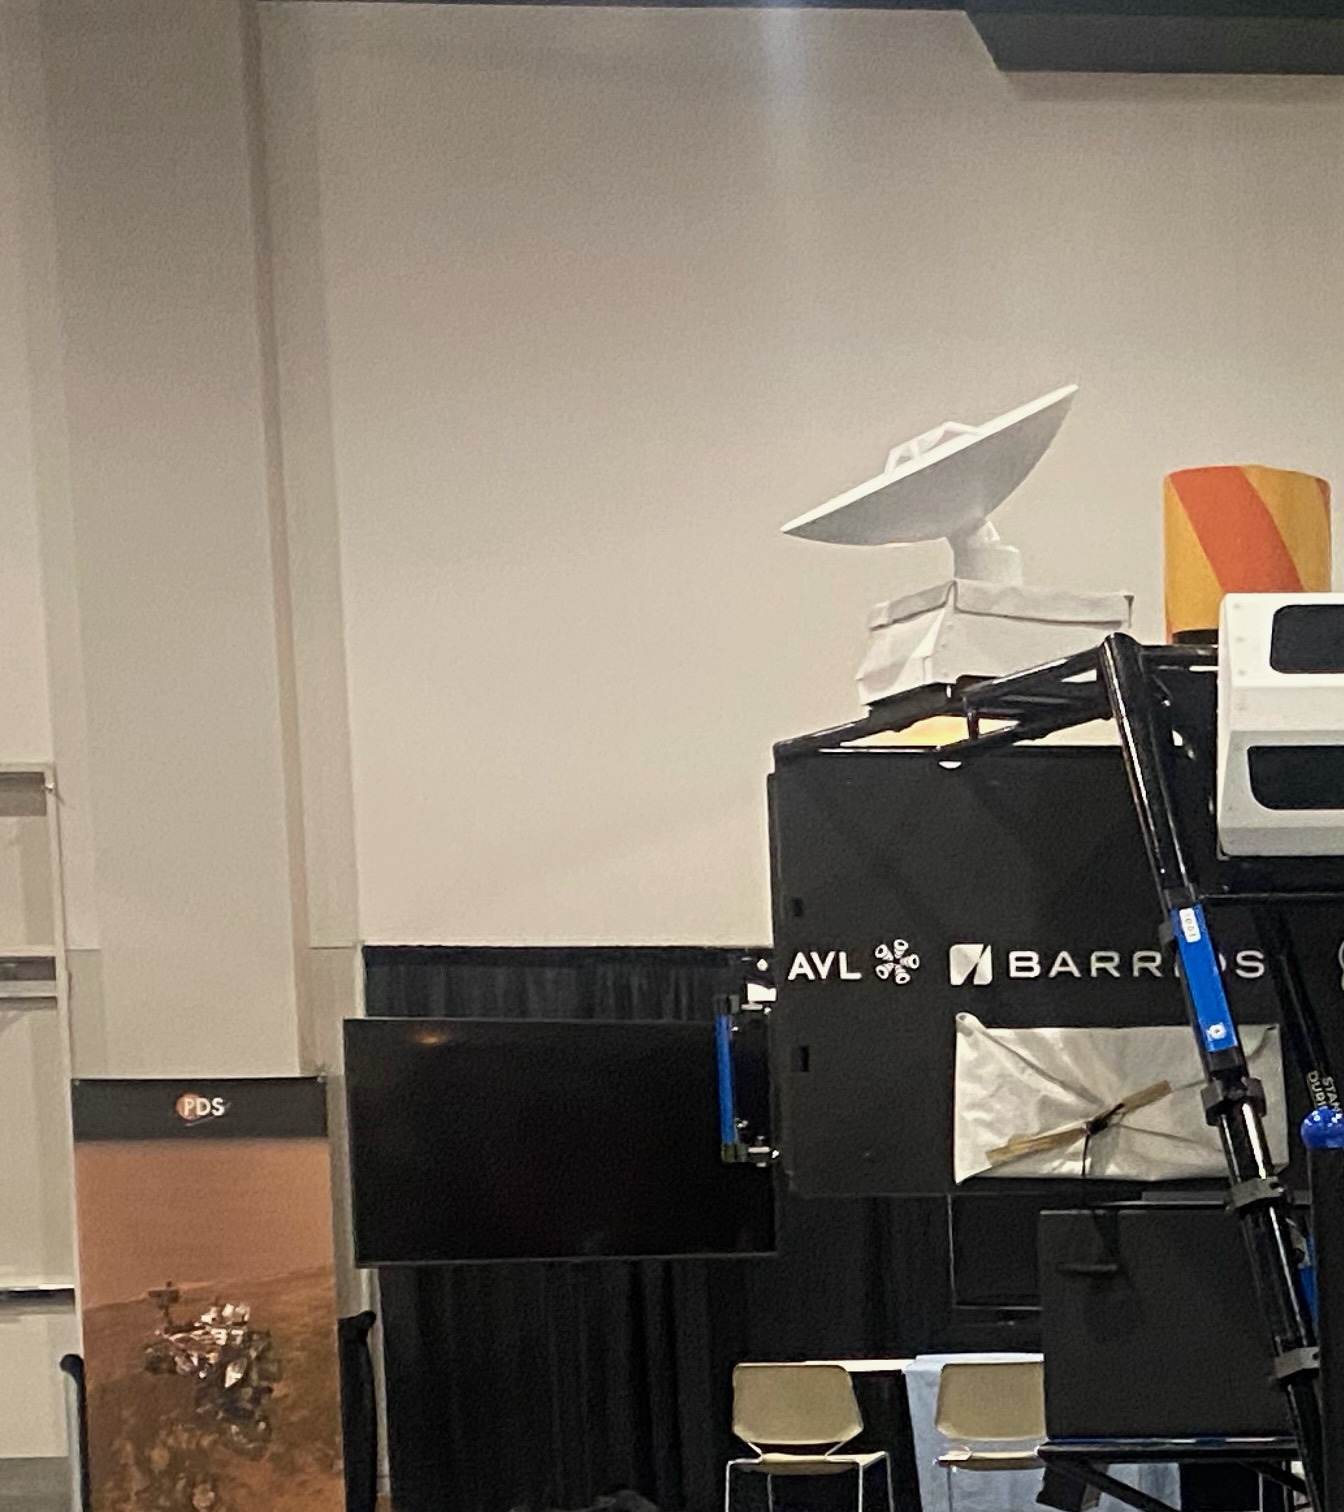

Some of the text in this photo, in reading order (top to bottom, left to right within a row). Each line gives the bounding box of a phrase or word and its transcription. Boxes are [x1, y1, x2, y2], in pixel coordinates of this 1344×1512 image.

[787, 951, 861, 981] AVL
[1008, 949, 1265, 979] BARRS
[183, 1097, 225, 1116] PDS
